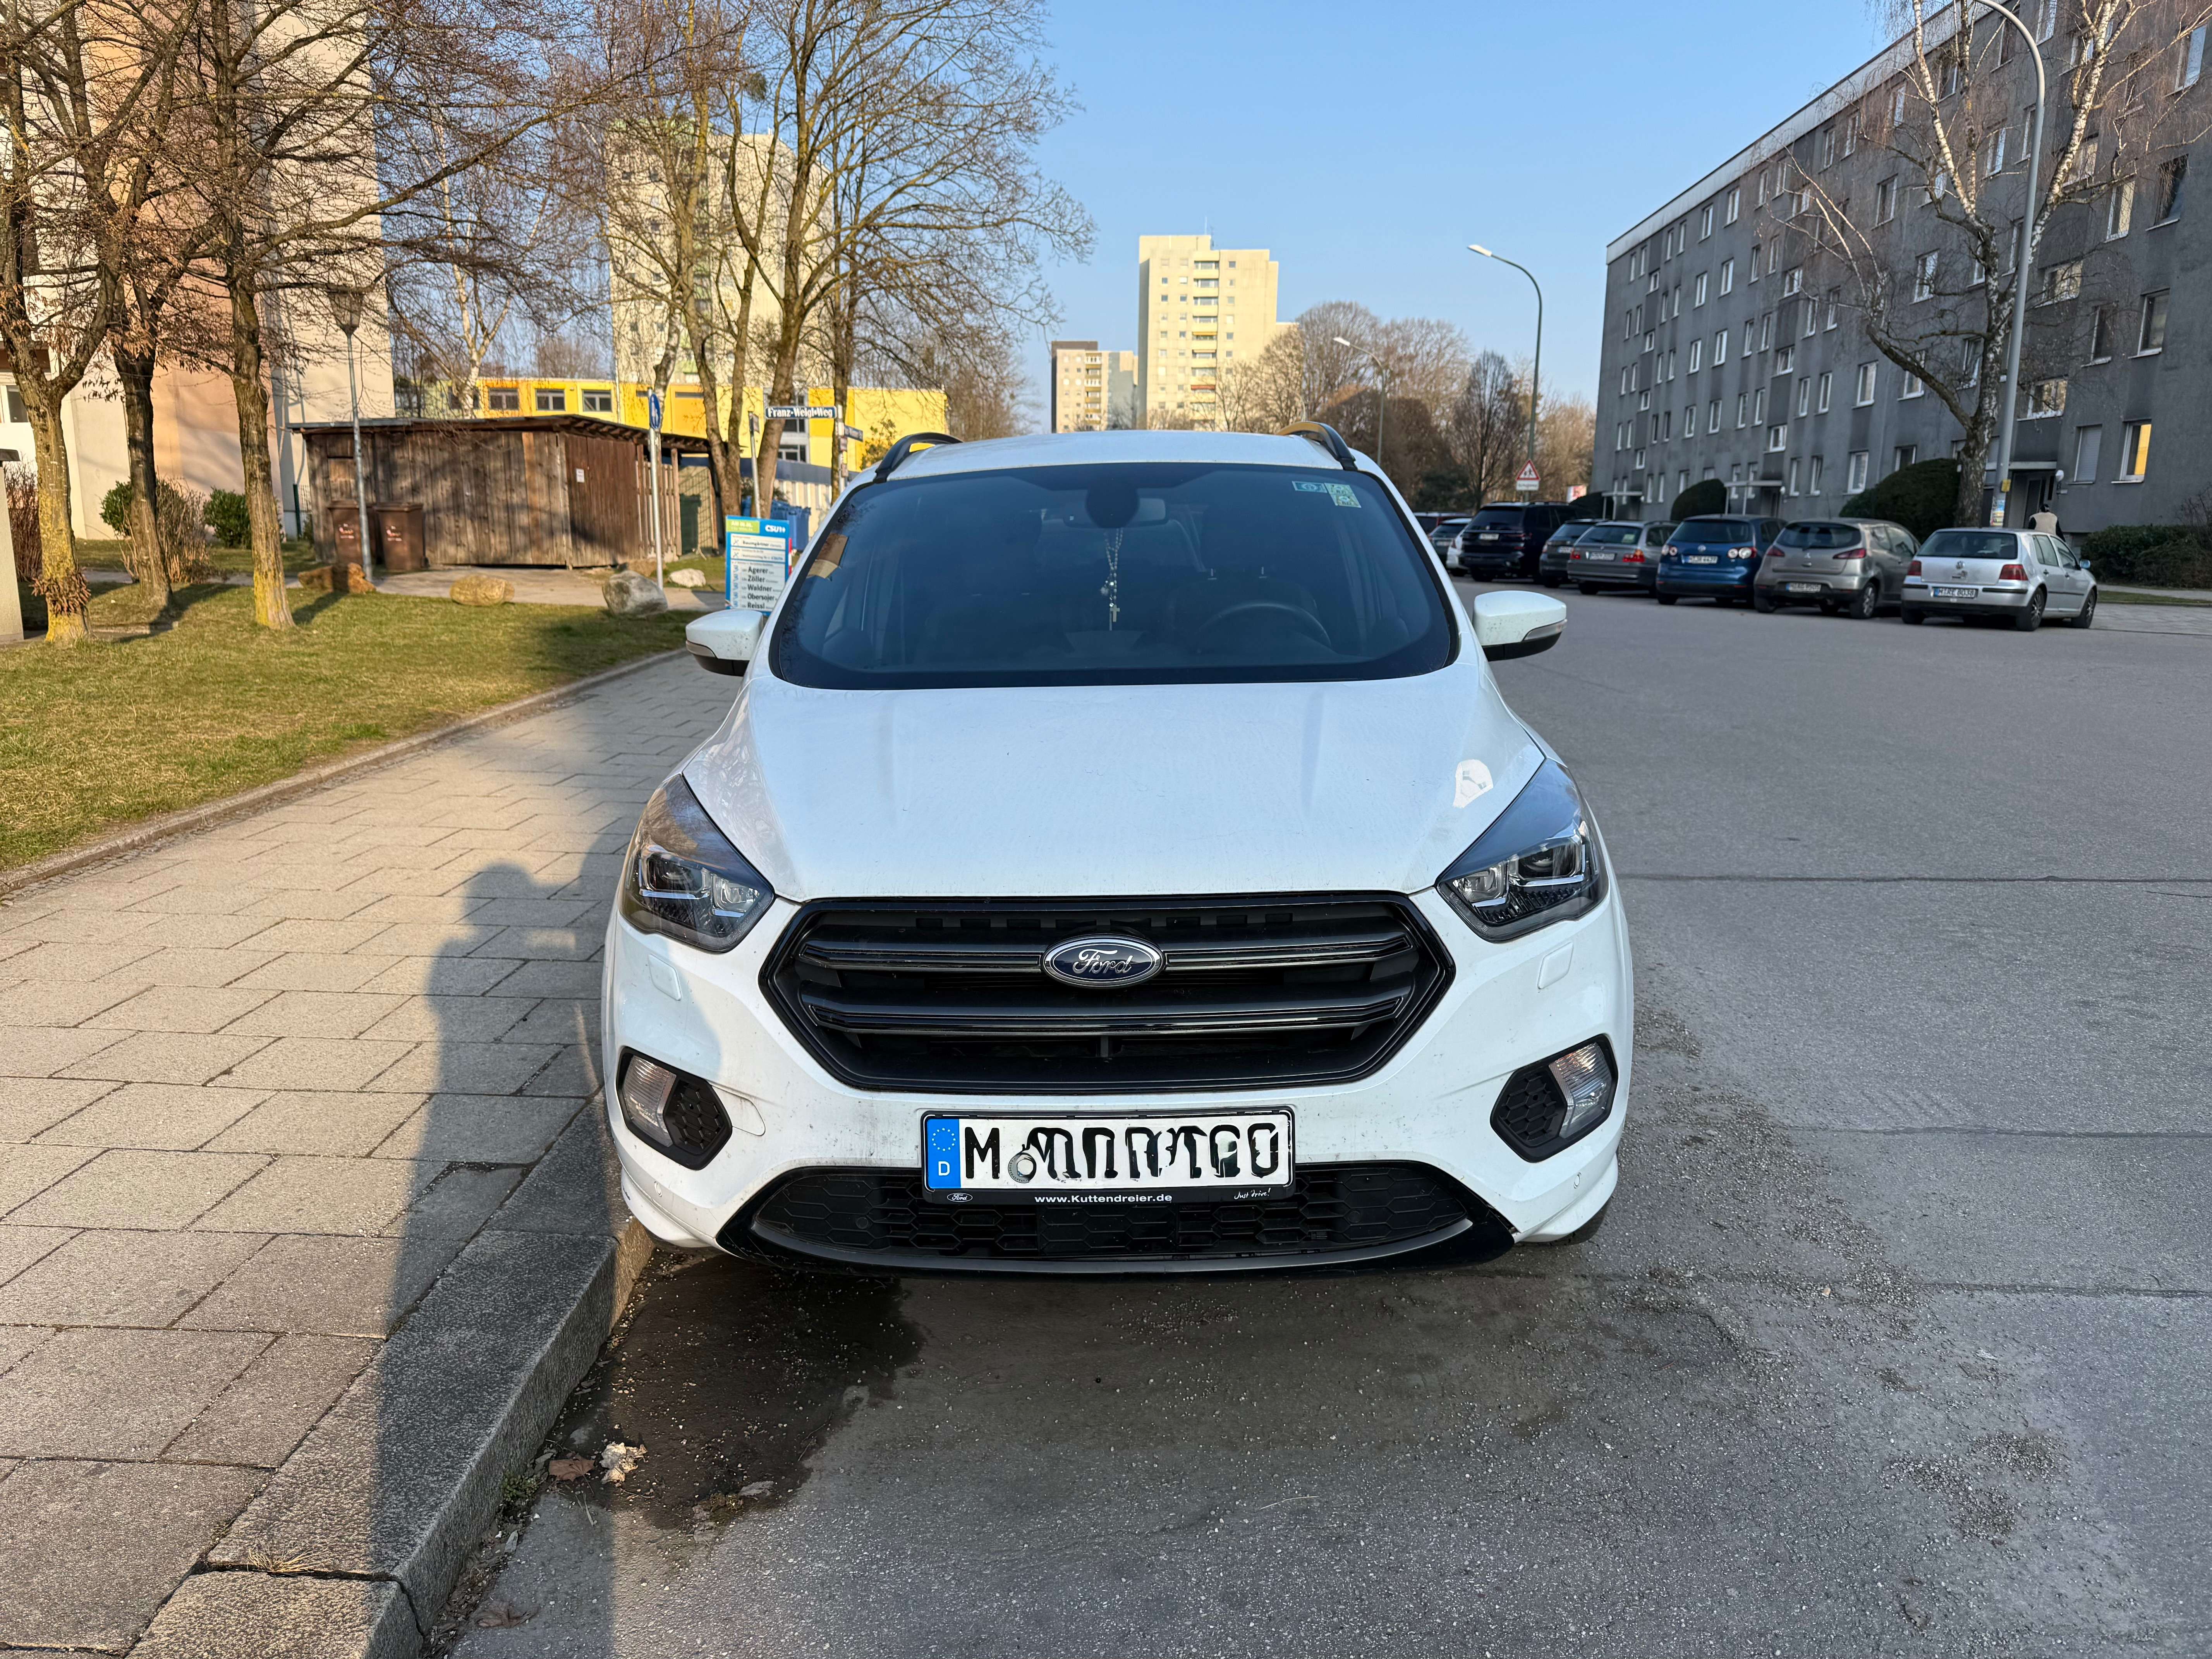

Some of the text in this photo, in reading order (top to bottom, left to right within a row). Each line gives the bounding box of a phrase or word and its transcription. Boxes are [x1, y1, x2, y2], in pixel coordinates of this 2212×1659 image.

[768, 407, 833, 418] Franz-Weigl-Weg
[765, 524, 779, 532] CSU
[747, 593, 775, 602] Obersojer
[1072, 949, 1133, 974] Ford
[938, 1161, 950, 1176] D
[1034, 1194, 1172, 1203] www.Kuttendreier.de
[1234, 1187, 1271, 1199] Just drive!
